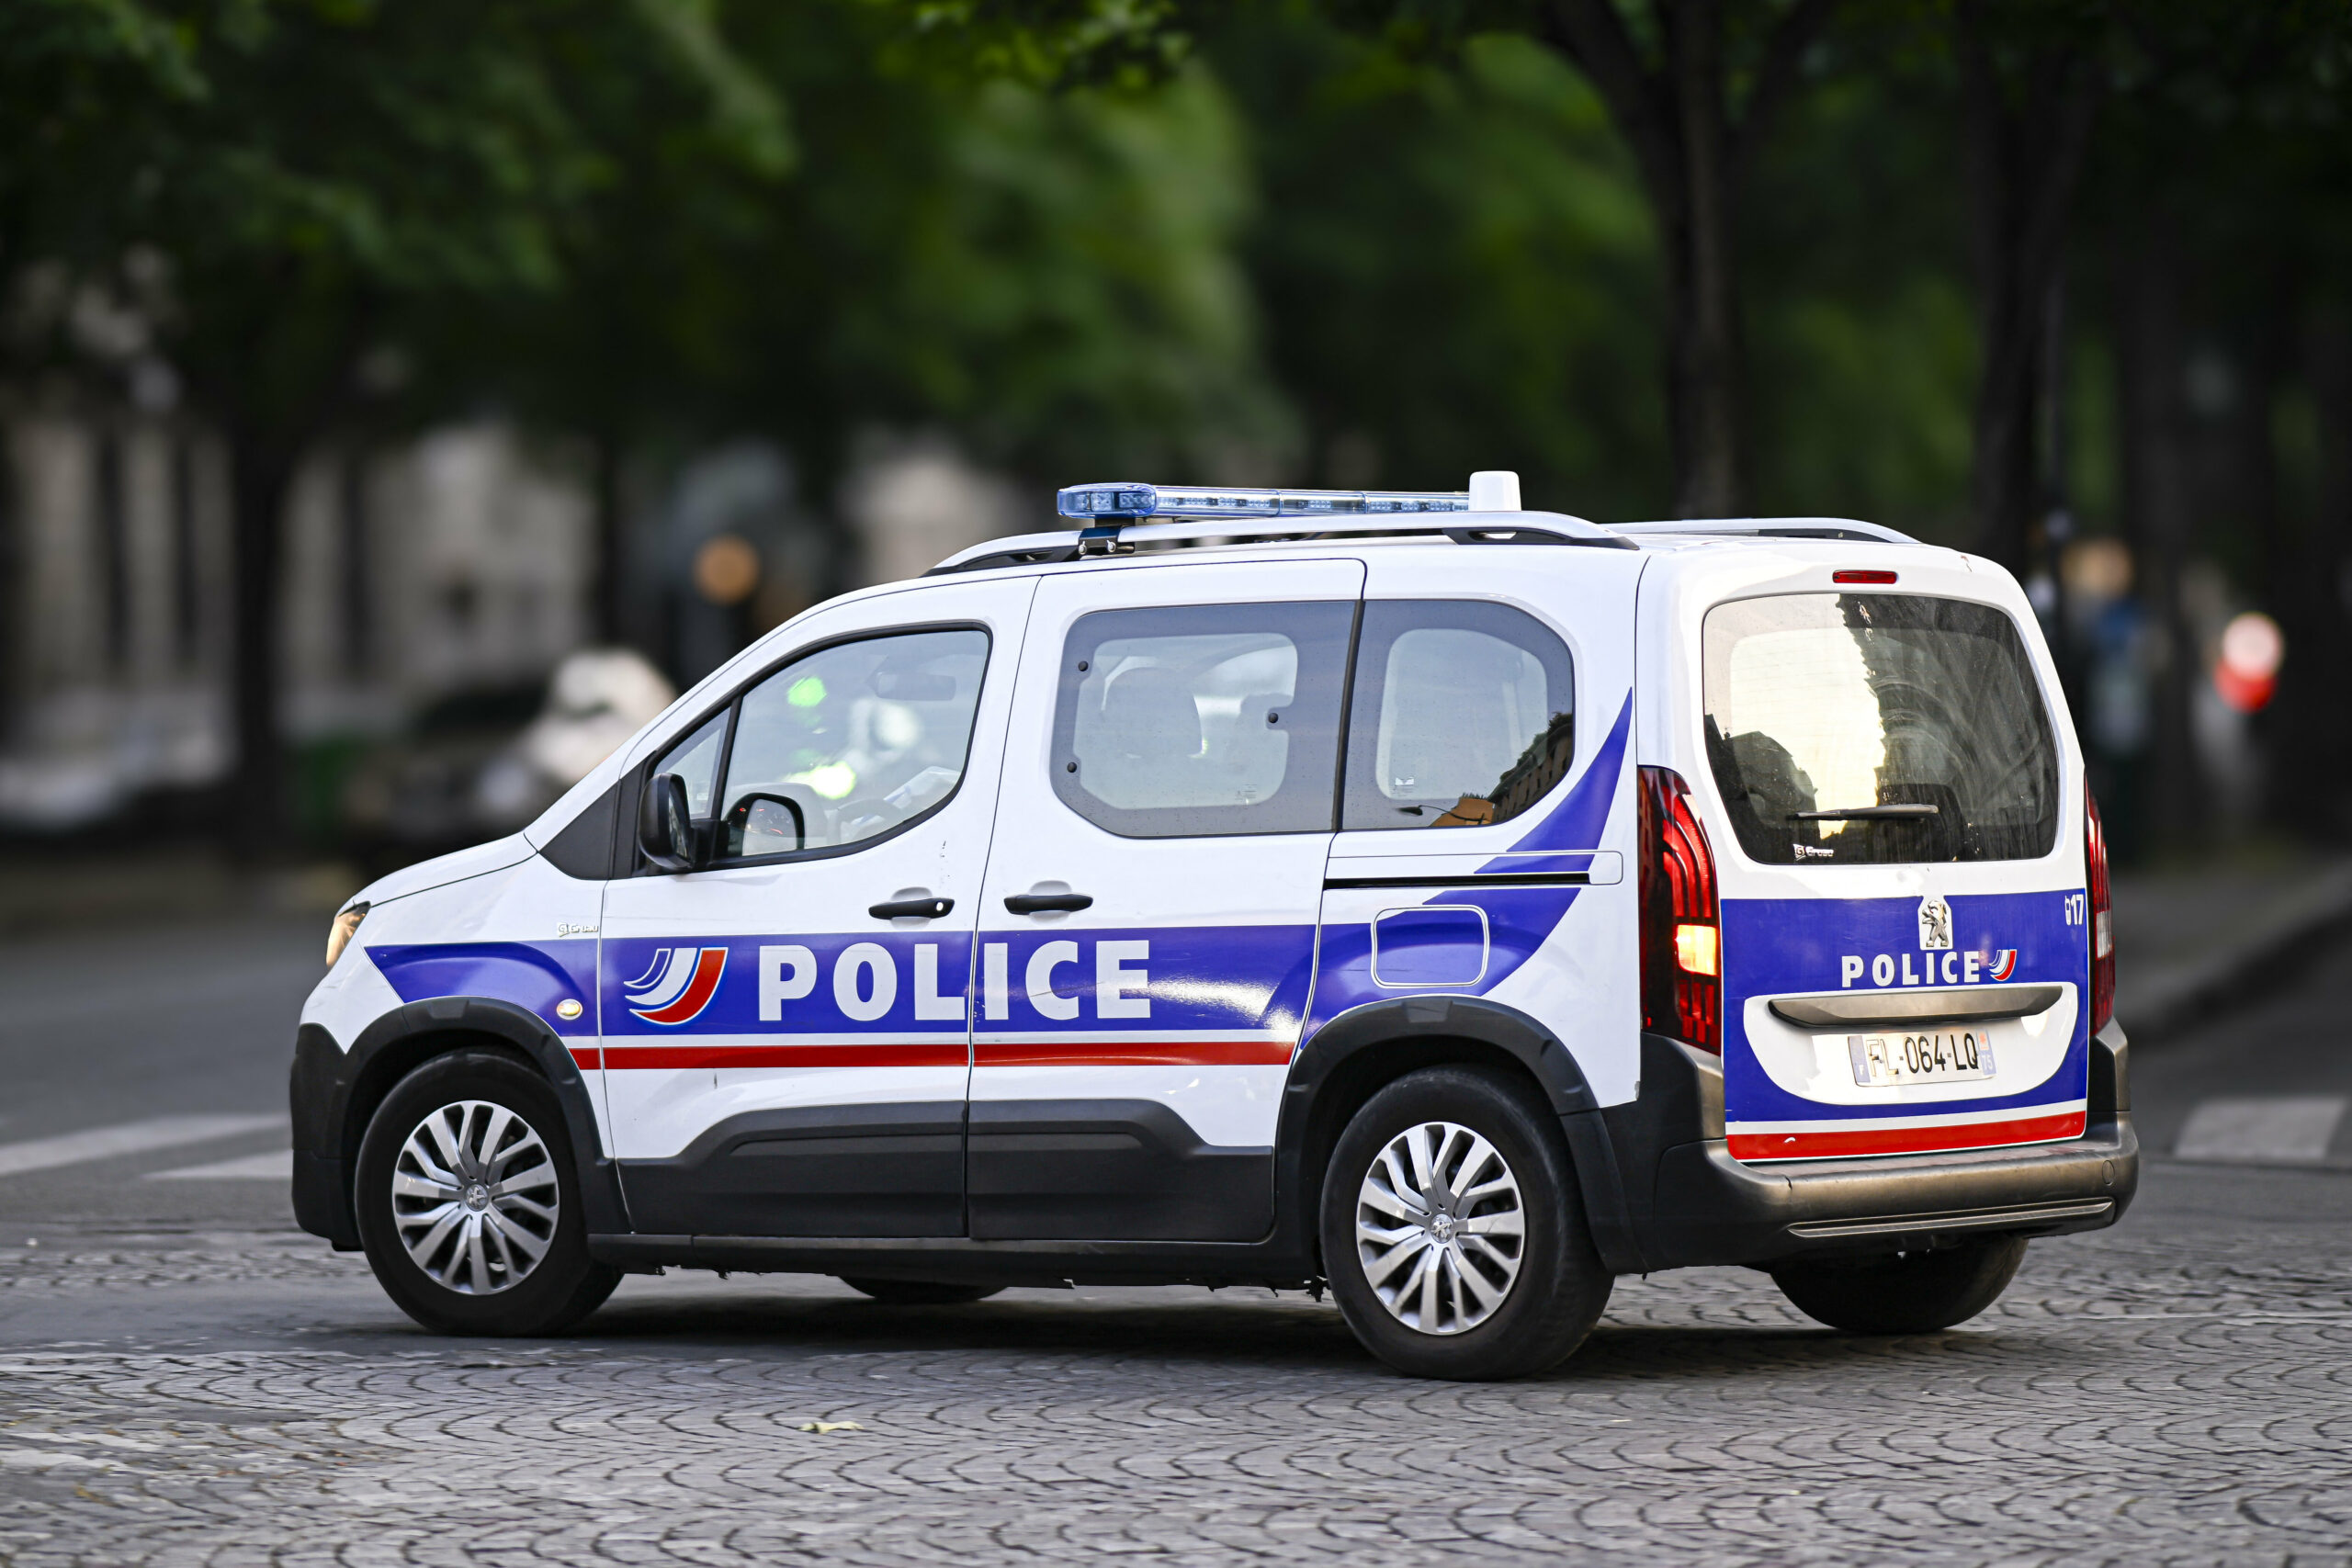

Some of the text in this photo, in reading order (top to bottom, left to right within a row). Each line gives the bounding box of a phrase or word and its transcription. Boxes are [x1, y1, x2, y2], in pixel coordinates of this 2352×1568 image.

[2070, 894, 2084, 925] 17
[759, 941, 1151, 1021] POLICE
[1841, 952, 1980, 987] POLICE
[1982, 1054, 1994, 1072] 75
